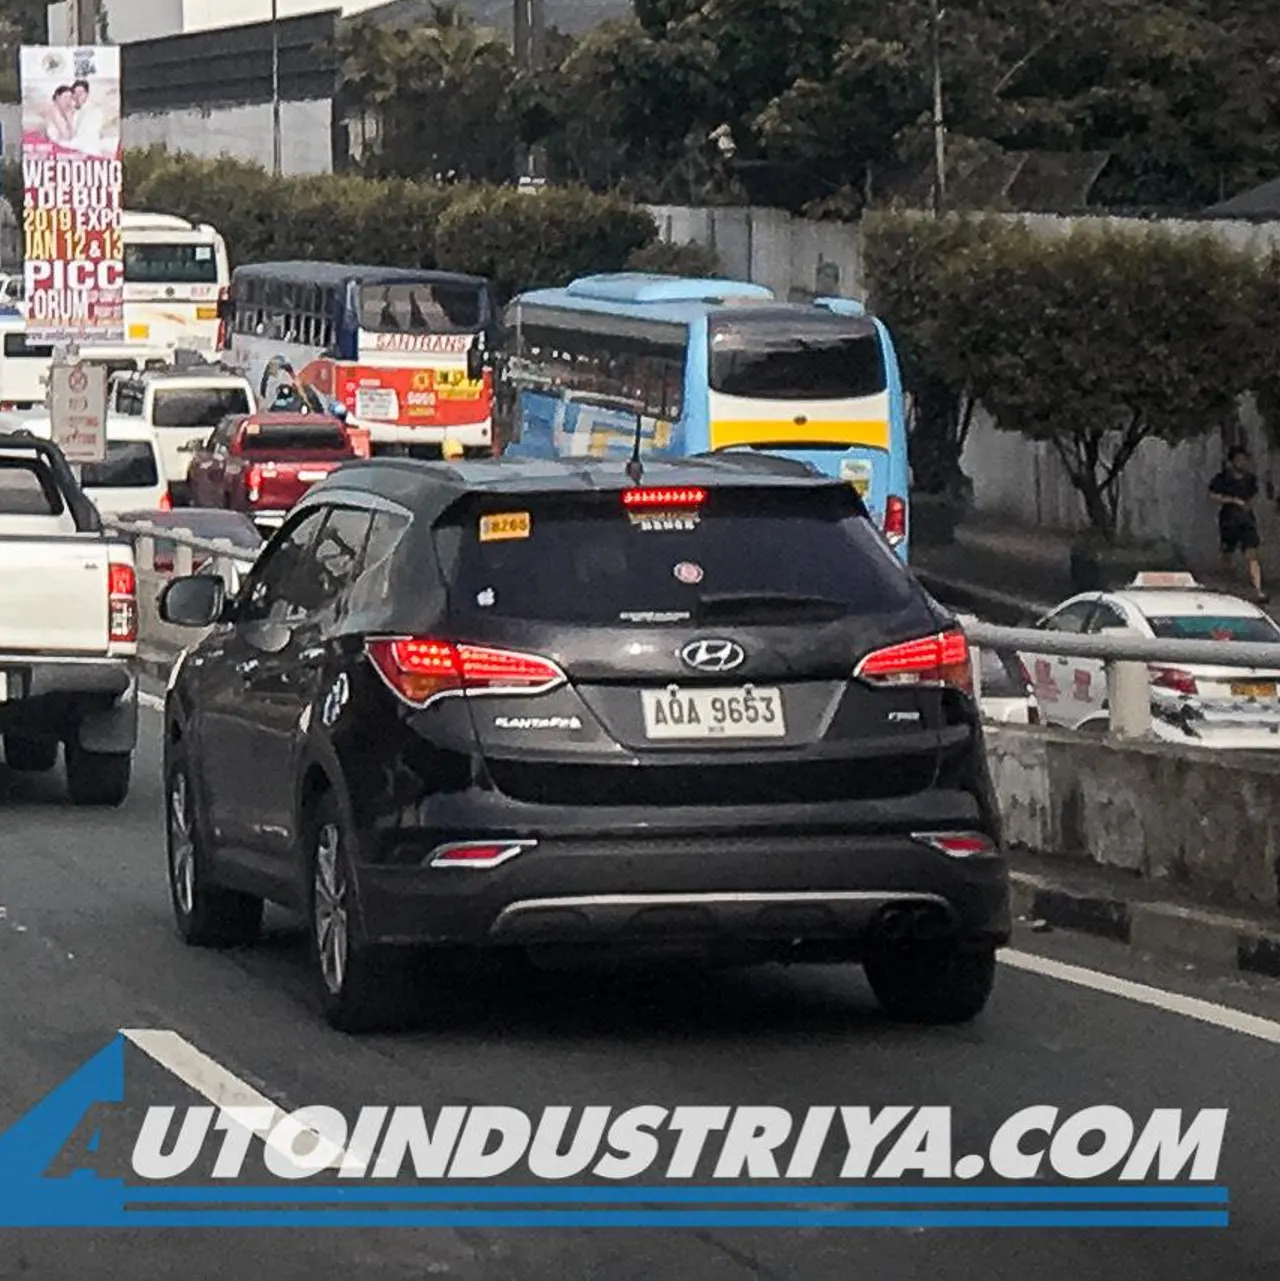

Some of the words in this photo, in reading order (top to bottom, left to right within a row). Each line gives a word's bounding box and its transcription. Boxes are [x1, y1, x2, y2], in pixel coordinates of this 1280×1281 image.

[22, 159, 123, 188] WEDDING
[38, 186, 122, 209] DEBUT
[76, 208, 124, 232] EXPO
[24, 230, 58, 260] JAN
[65, 231, 86, 260] 12
[89, 239, 101, 258] &
[103, 231, 124, 260] 13
[25, 260, 124, 290] PICC
[25, 289, 88, 320] FORUM
[654, 696, 701, 726] AQA
[710, 695, 776, 724] 9653
